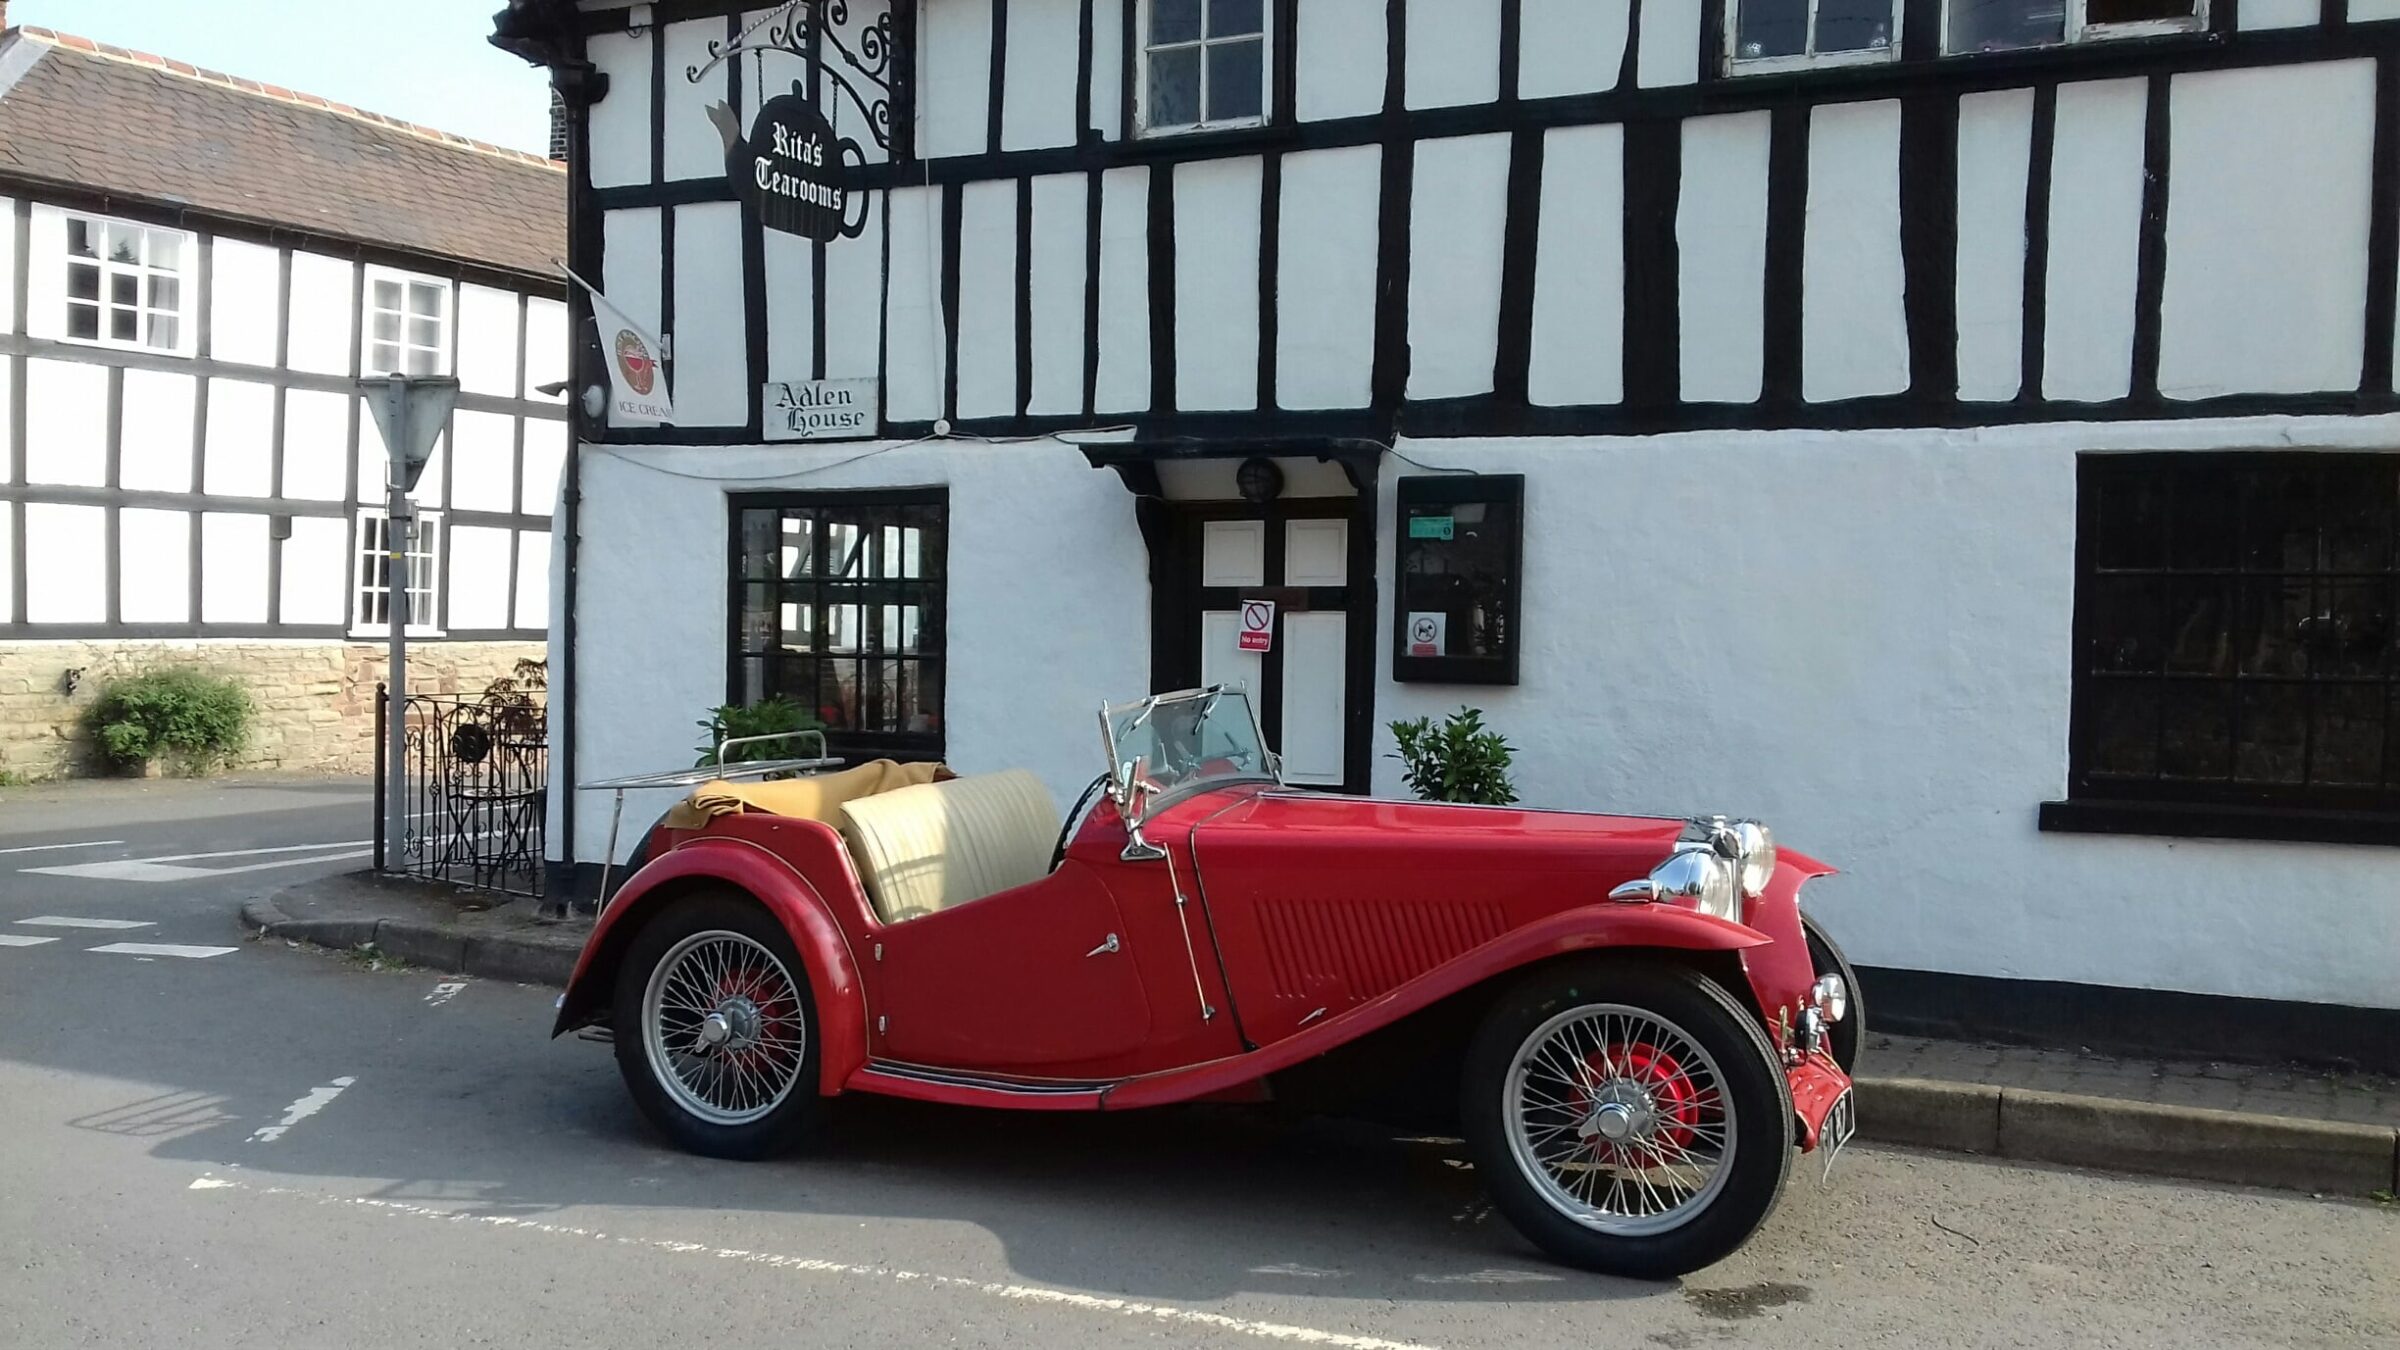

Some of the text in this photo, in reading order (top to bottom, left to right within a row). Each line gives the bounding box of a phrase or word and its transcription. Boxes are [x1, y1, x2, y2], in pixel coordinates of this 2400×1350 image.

[772, 122, 823, 168] Rita's
[755, 156, 842, 211] Tearooms
[619, 401, 637, 414] ICE
[775, 383, 853, 408] Adlen
[787, 406, 865, 437] House
[1241, 635, 1268, 646] No entry
